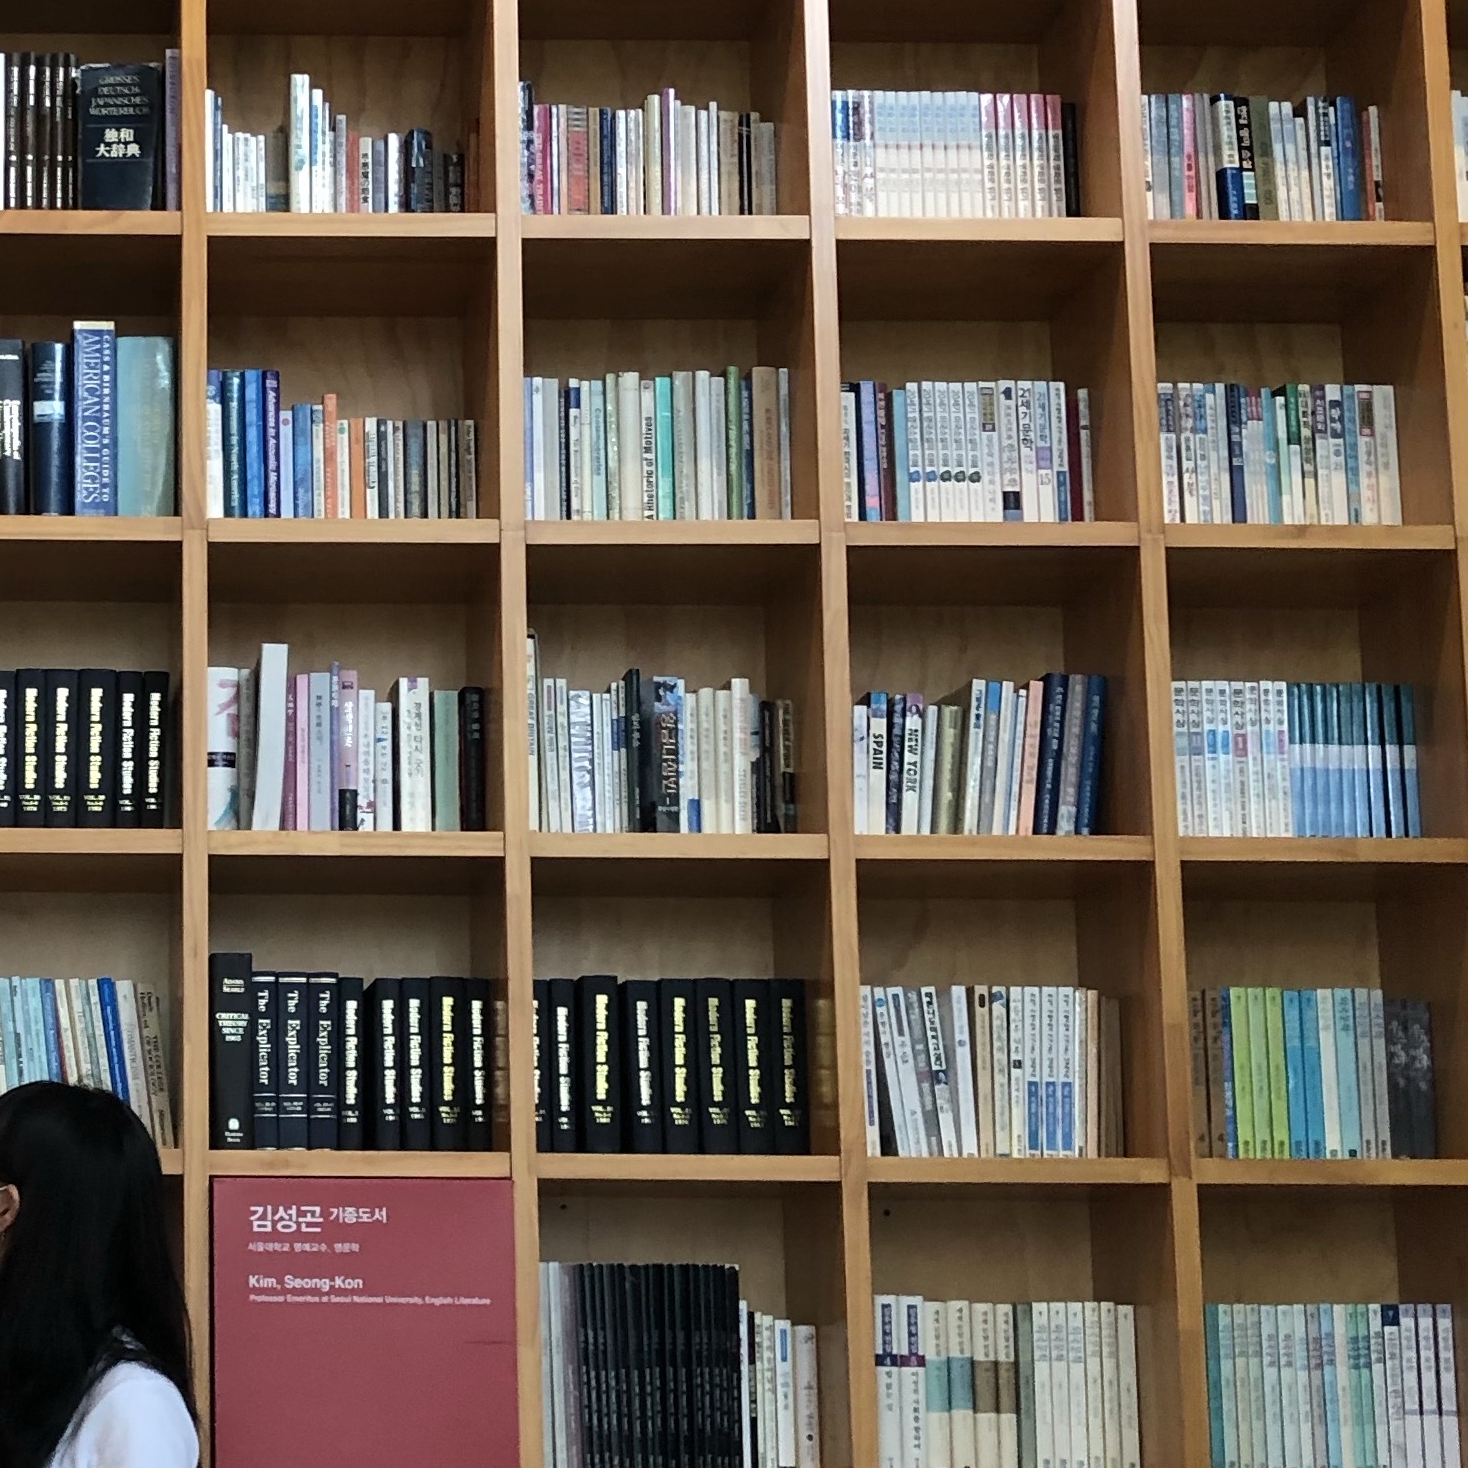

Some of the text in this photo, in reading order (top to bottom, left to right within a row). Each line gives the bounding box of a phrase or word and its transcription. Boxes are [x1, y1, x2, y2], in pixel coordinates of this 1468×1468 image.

[96, 144, 141, 158] 大辞典
[102, 335, 110, 362] CASS
[82, 335, 100, 503] AMERICAN COLLEGES
[102, 375, 110, 444] BIRNBAUM'S
[268, 391, 277, 427] Advances
[643, 416, 653, 453] Motives
[102, 448, 110, 483] GUIDE
[269, 439, 277, 470] Acoustic
[644, 458, 654, 466] of
[102, 487, 110, 502] TO
[268, 472, 277, 514] Microscopy
[645, 470, 654, 510] Rhetoric
[871, 733, 885, 770] SPAIN
[906, 729, 918, 793] NEW YORK
[257, 990, 271, 1084] The Explicator
[286, 991, 300, 1085] The Explicator
[442, 997, 454, 1101] Modern Fiction Studies
[596, 994, 608, 1100] Modern Fiction Studies
[249, 1205, 387, 1233] 김성곤 기증도서
[248, 1242, 289, 1252] 서울대학교
[334, 1242, 359, 1253] 영문학
[249, 1276, 363, 1291] Kim, Seong-Kon
[250, 1294, 284, 1302] Professor
[330, 1295, 351, 1303] Seoul
[353, 1295, 383, 1303] National
[385, 1296, 423, 1305] University,
[425, 1296, 453, 1306] English
[455, 1297, 491, 1305] Literature
